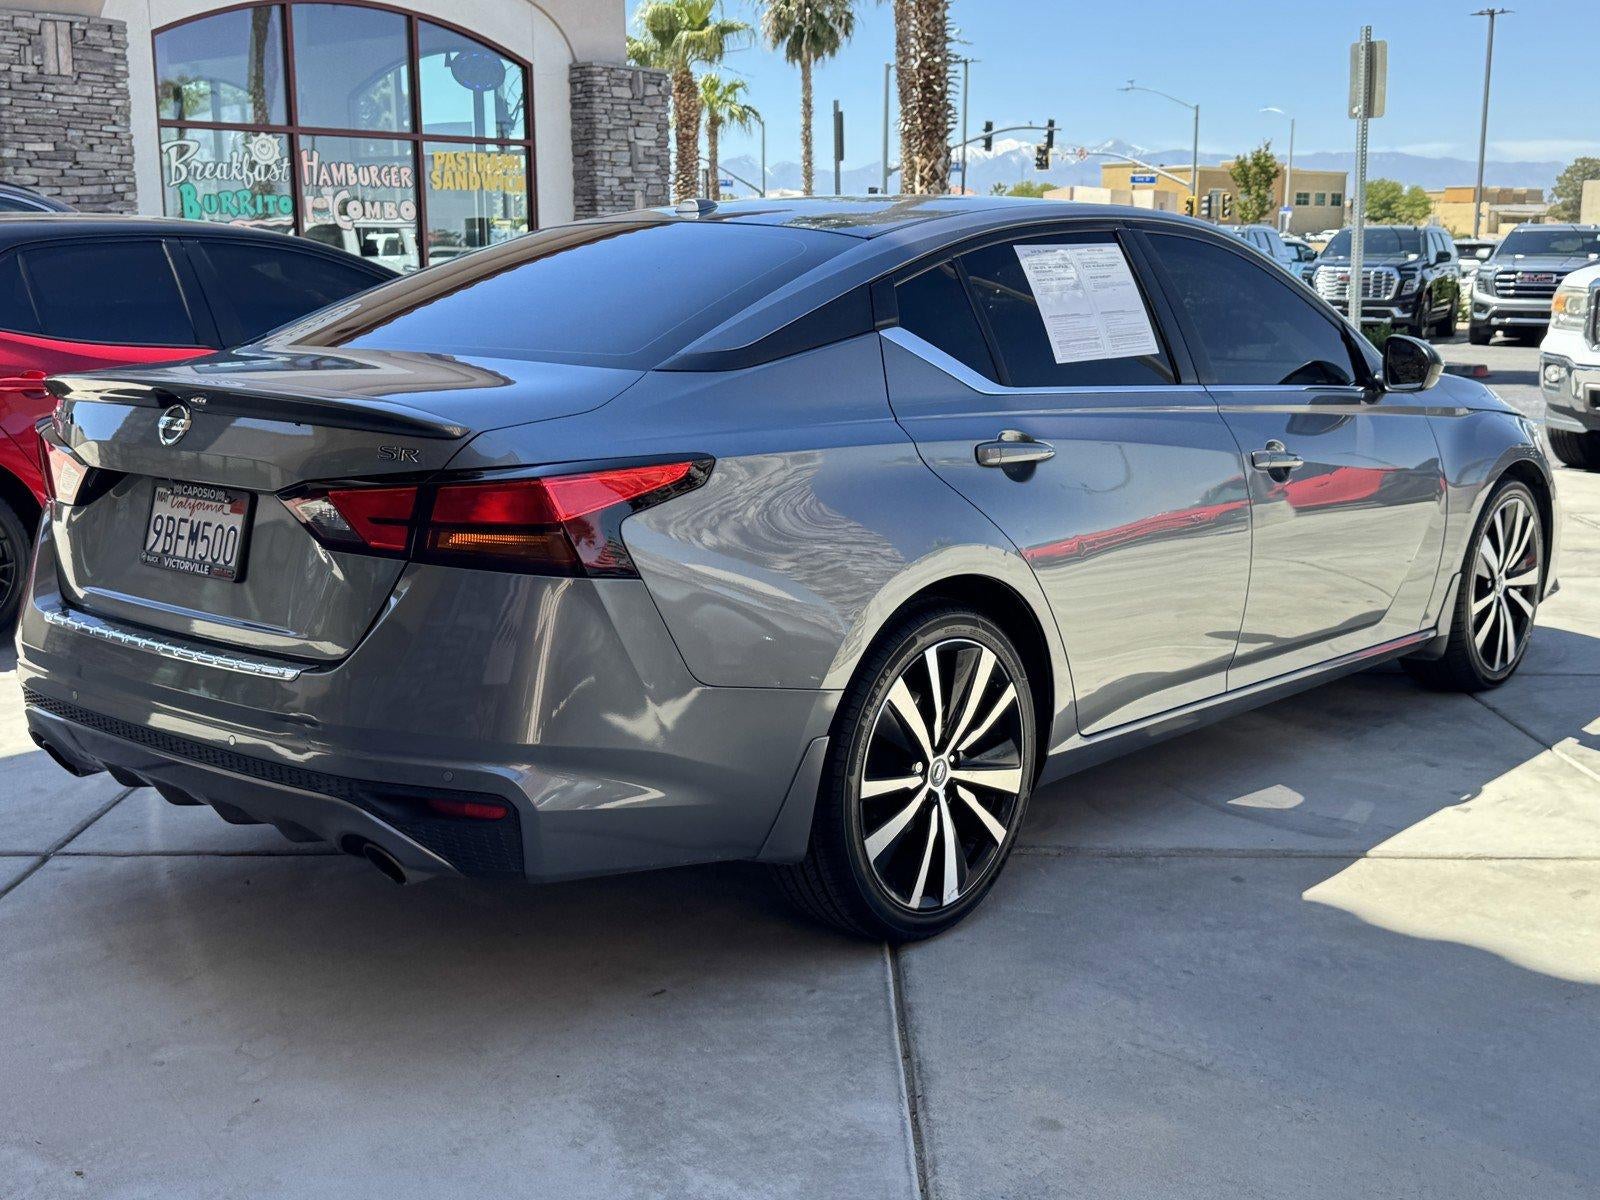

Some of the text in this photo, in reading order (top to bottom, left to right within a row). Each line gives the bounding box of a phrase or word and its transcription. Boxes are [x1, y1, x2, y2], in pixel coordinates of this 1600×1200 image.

[161, 139, 291, 189] Breakfast
[301, 149, 414, 188] HAMBURGER
[179, 183, 293, 220] BURRITO
[333, 189, 417, 231] COMBO
[377, 445, 419, 463] SR
[170, 496, 230, 516] California
[182, 485, 216, 499] CAPOSIO
[147, 514, 238, 567] 9BFM500
[163, 557, 210, 575] VICTORVILLE
